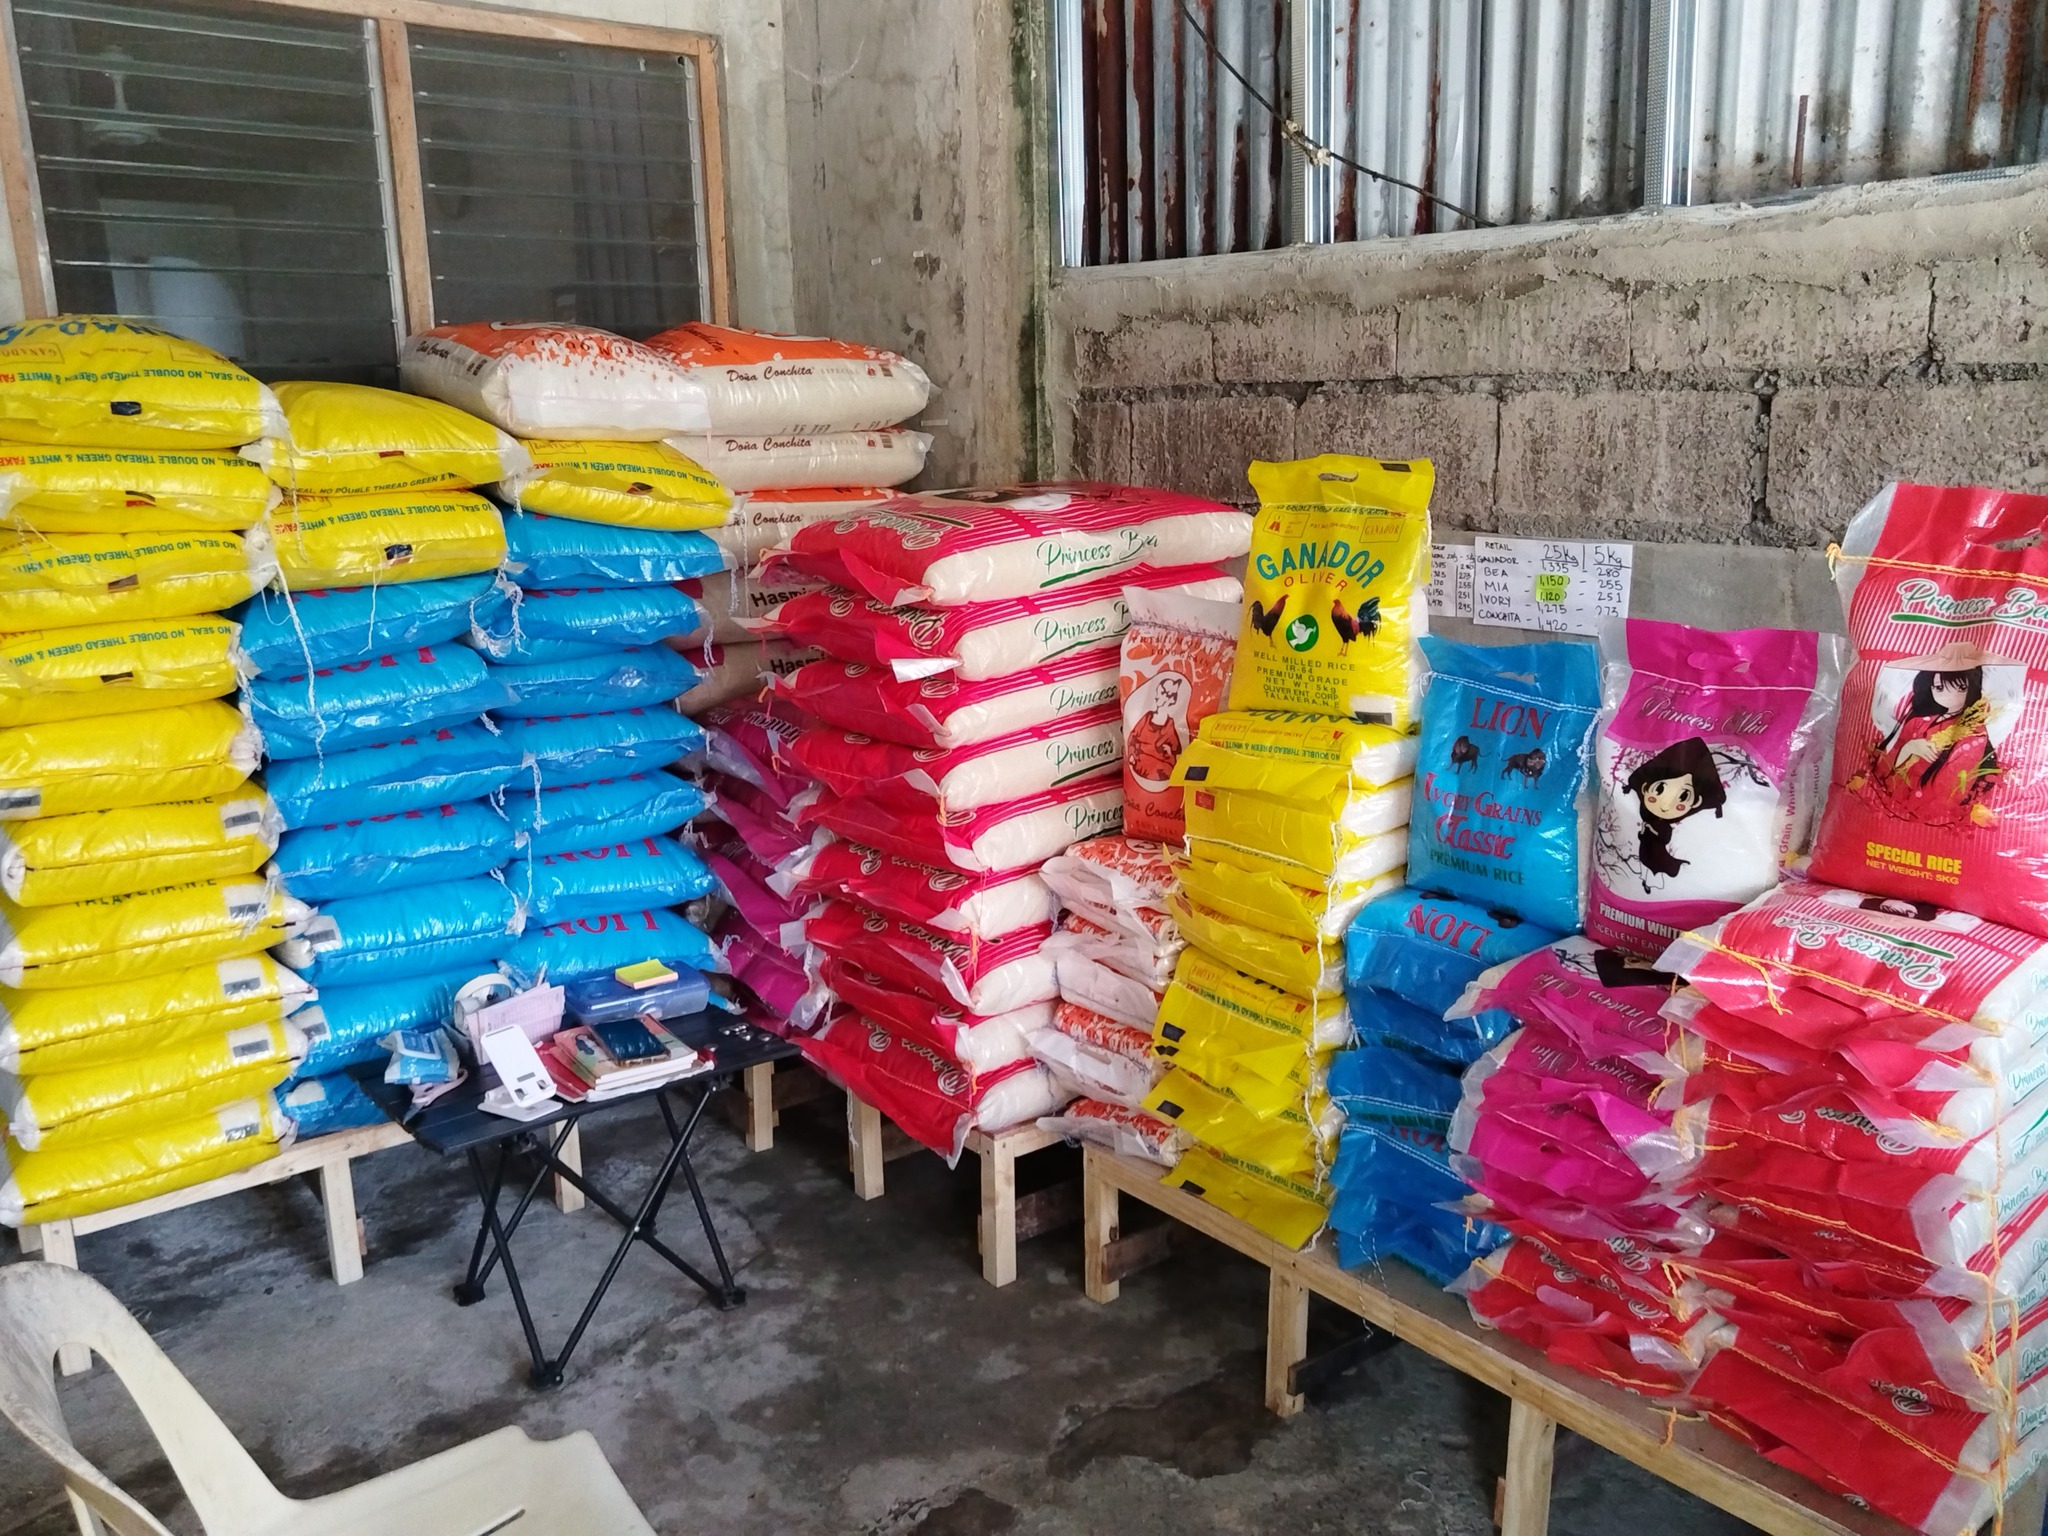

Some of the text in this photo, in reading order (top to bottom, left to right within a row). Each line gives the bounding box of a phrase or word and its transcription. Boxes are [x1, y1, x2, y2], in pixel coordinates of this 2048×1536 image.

[17, 372, 52, 382] WHITE
[143, 369, 185, 380] DOUBLE
[188, 370, 202, 380] NO
[763, 436, 812, 451] Conchita
[28, 455, 63, 464] WHITE
[65, 454, 72, 462] &
[76, 454, 112, 462] GREEN
[115, 454, 154, 464] THREAD
[159, 454, 199, 466] DOUBLE
[201, 456, 216, 466] NO
[590, 462, 615, 472] GREEN
[616, 463, 646, 474] THREAD
[647, 466, 676, 478] DOUBLE
[677, 471, 688, 480] NO
[373, 482, 408, 491] THREAD
[409, 475, 438, 486] GREEN
[368, 506, 405, 518] THREAD
[406, 504, 440, 516] DOUBLE
[442, 504, 456, 512] NO
[338, 511, 368, 523] GREEN
[753, 512, 802, 526] Conchita
[135, 542, 175, 558] DOUBLE
[177, 541, 192, 551] NO
[1484, 542, 1512, 552] RETAIL
[56, 553, 92, 566] GREEN
[94, 550, 134, 562] THREAD
[1036, 540, 1112, 575] Princess
[1477, 555, 1519, 565] GANADOR
[1256, 540, 1385, 590] GANADOR
[1284, 572, 1348, 592] OLIVER
[1484, 567, 1509, 578] BEA
[1598, 580, 1624, 590] 255
[1484, 581, 1510, 593] MIA
[1598, 592, 1622, 603] 251
[1897, 578, 1996, 616] Princess
[1480, 593, 1512, 606] IVORY
[1478, 610, 1521, 622] CONCHITA
[129, 630, 168, 644] DOUBLE
[171, 629, 185, 639] NO
[218, 626, 232, 635] NO
[1034, 616, 1106, 650] Princess
[85, 635, 127, 650] THREAD
[36, 651, 44, 660] &
[46, 643, 83, 658] GREEN
[1253, 650, 1356, 672] WELL MILLED RICE
[1286, 664, 1313, 674] IR-64
[1256, 666, 1348, 686] PREMIUM GRADE
[1266, 676, 1286, 686] NET
[1264, 684, 1291, 694] OLIVER
[1314, 692, 1339, 700] CORP
[1050, 685, 1118, 716] Princess
[1469, 697, 1552, 739] LION
[1640, 696, 1719, 732] Princess
[1046, 738, 1114, 774] Princess
[1274, 746, 1300, 756] THREAD
[1302, 750, 1330, 760] DOUBLE
[1064, 803, 1124, 838] Princes
[1779, 823, 1793, 854] Grain
[1866, 842, 1962, 875] SPECIAL RICE
[1430, 850, 1526, 886] PREMIUM RICE
[1866, 858, 1960, 885] NET WEIGHT: 5KG
[1600, 902, 1646, 930] PREMIUM
[1404, 904, 1493, 957] LION
[1836, 933, 1946, 990] Princess
